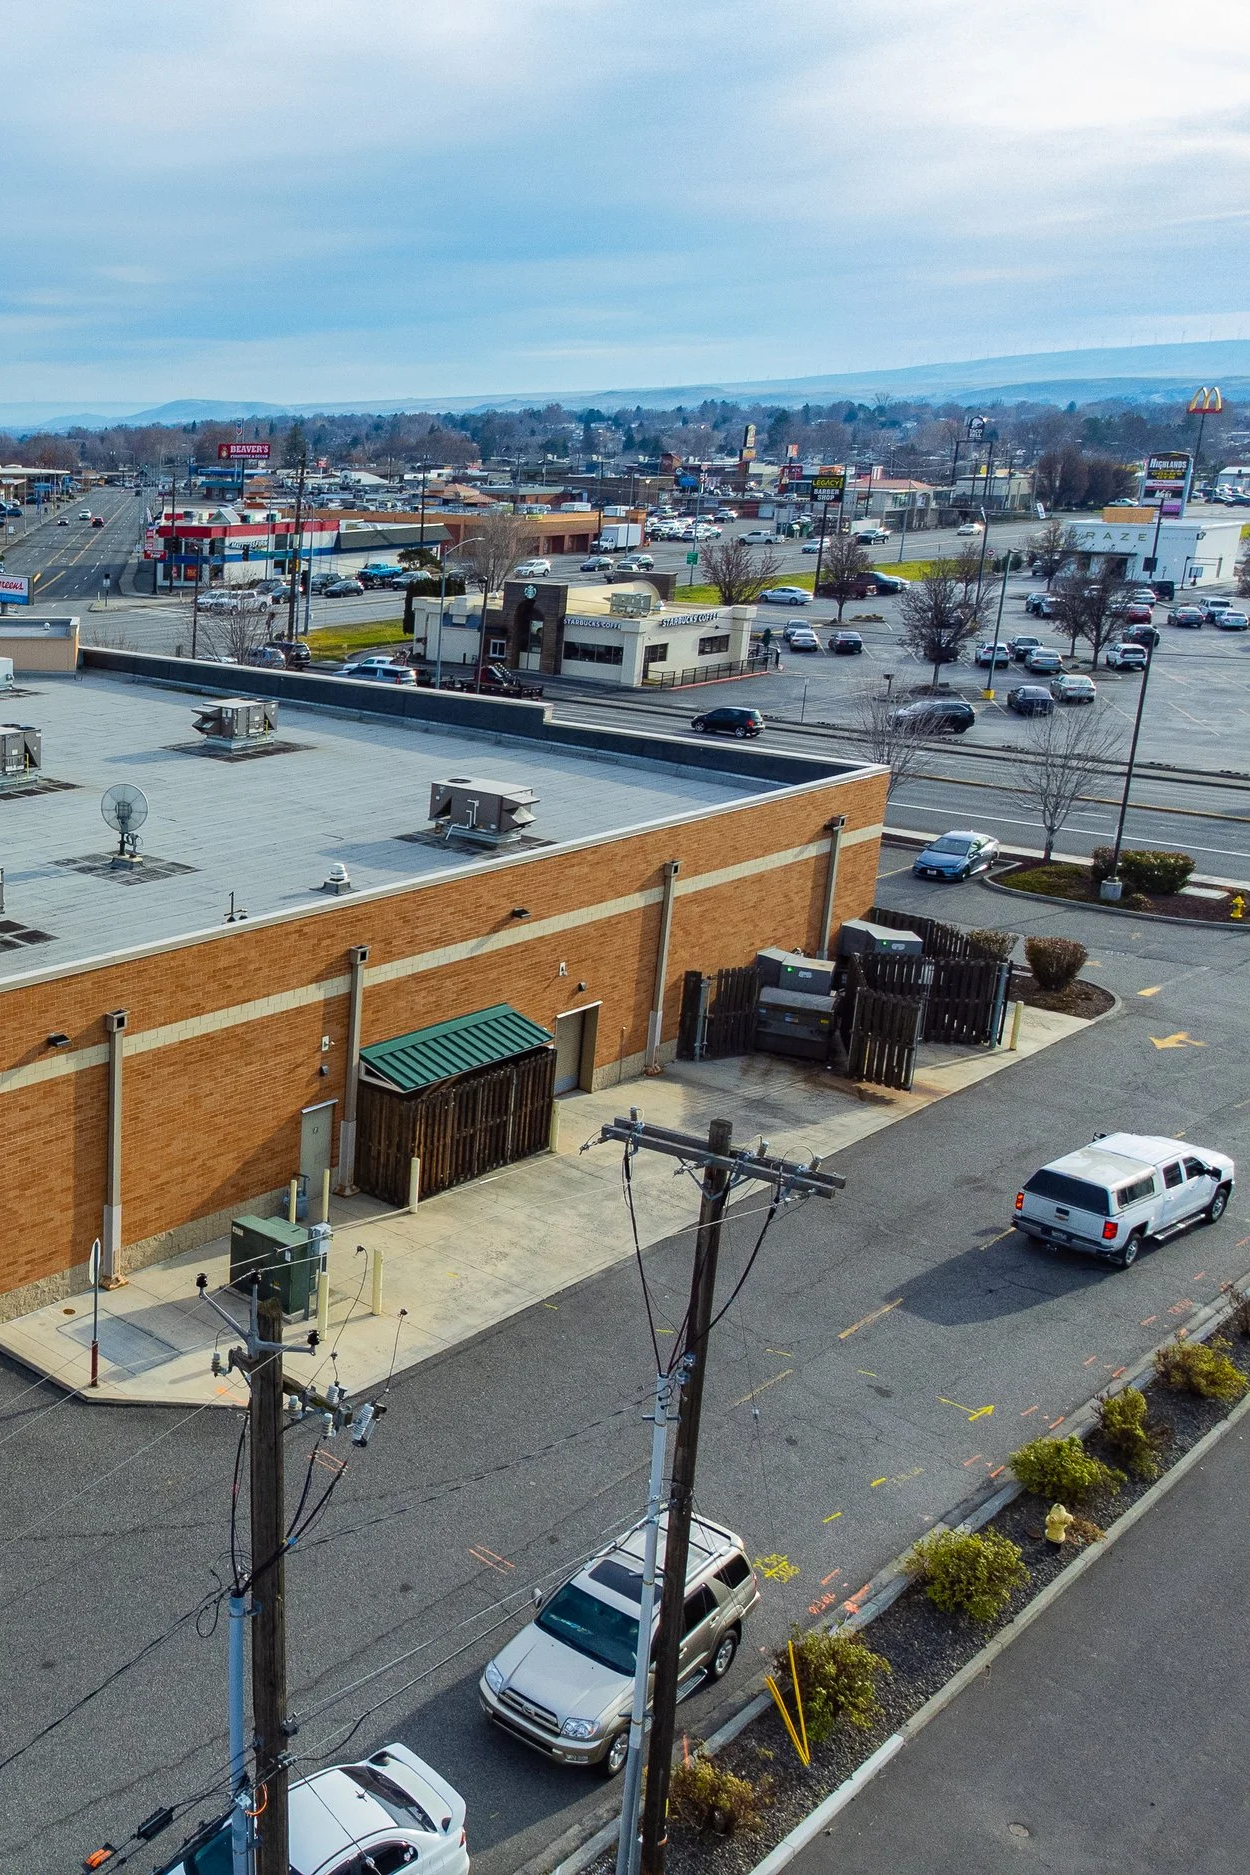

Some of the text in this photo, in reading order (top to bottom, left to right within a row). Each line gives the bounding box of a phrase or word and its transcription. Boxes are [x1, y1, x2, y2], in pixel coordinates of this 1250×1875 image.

[229, 445, 269, 454] BEAVER'S
[1149, 458, 1188, 469] HIGHLANDS
[563, 619, 600, 628] STARBUCKS
[661, 615, 698, 627] STARBUCKS
